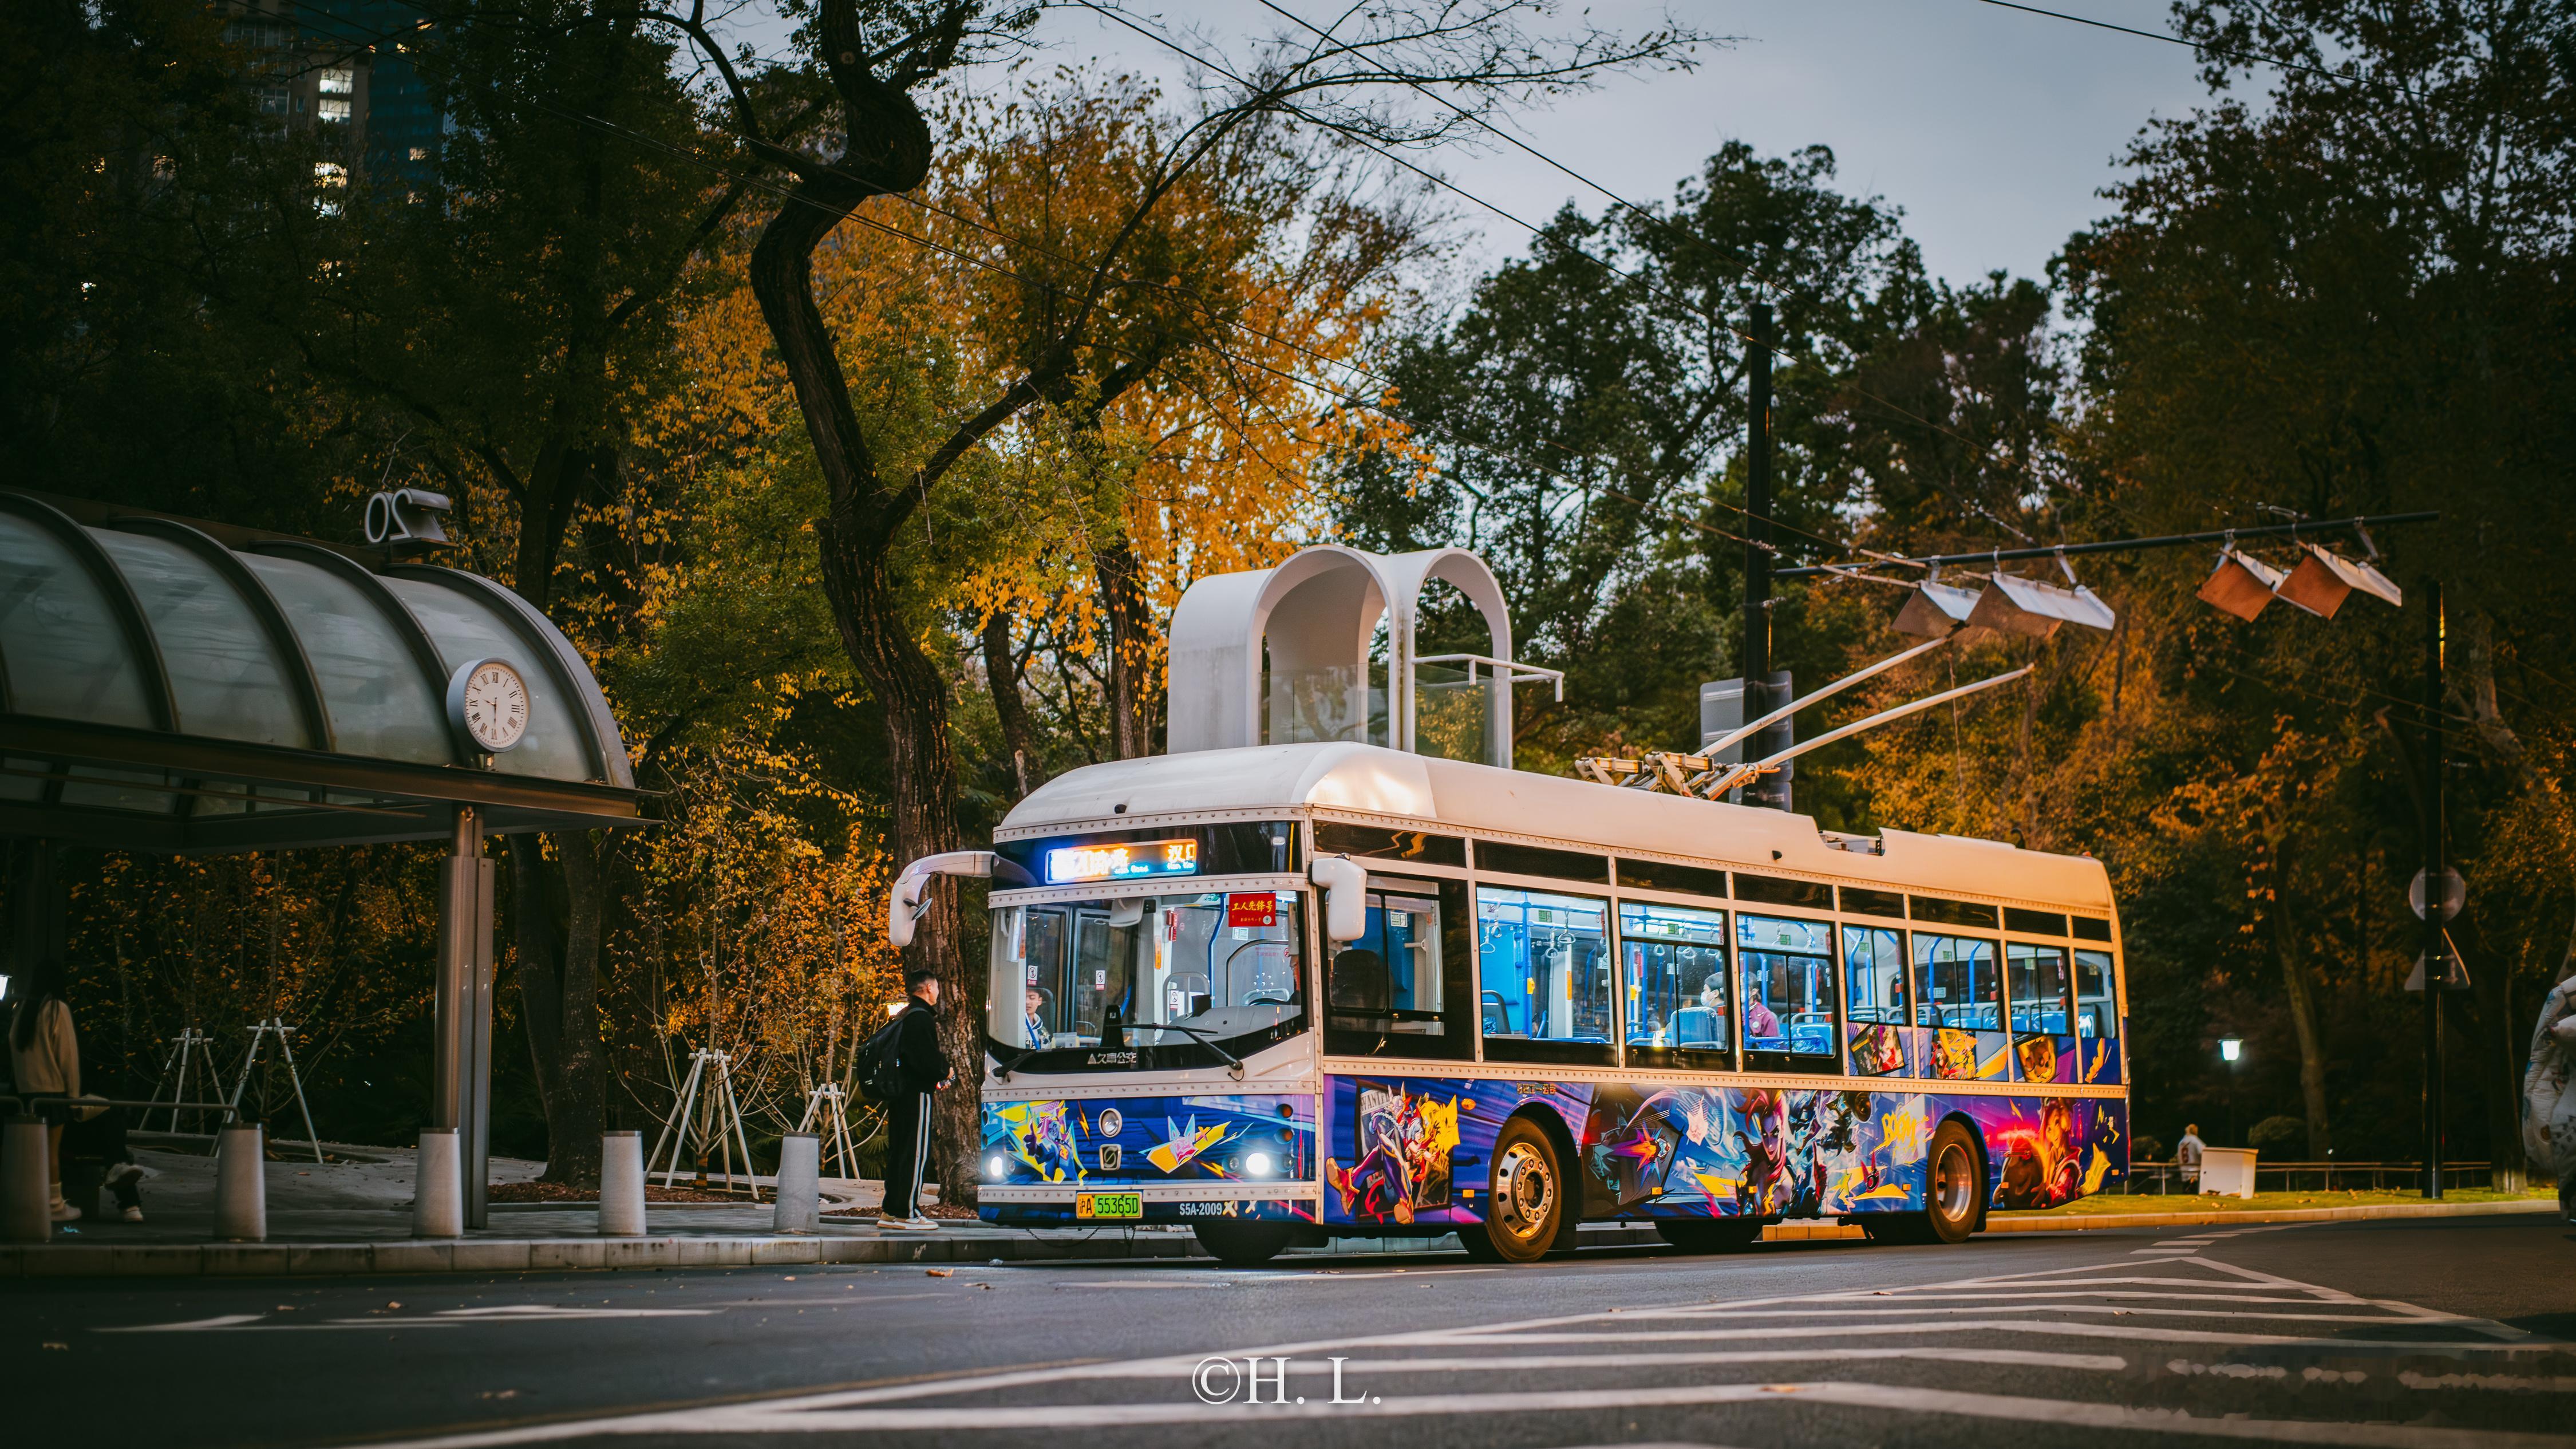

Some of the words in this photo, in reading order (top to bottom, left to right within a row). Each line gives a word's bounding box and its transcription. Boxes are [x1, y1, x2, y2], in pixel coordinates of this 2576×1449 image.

[503, 678, 509, 688] I
[509, 690, 517, 698] II
[469, 698, 479, 707] IX
[511, 705, 520, 713] III
[507, 716, 518, 729] IIII
[502, 727, 509, 738] V
[1232, 900, 1273, 913] 工人先锋号
[1096, 1052, 1137, 1064] 久事公交
[1079, 1198, 1092, 1214] 沪A
[1097, 1198, 1138, 1214] 55365D
[1179, 1202, 1223, 1216] S5A-2009
